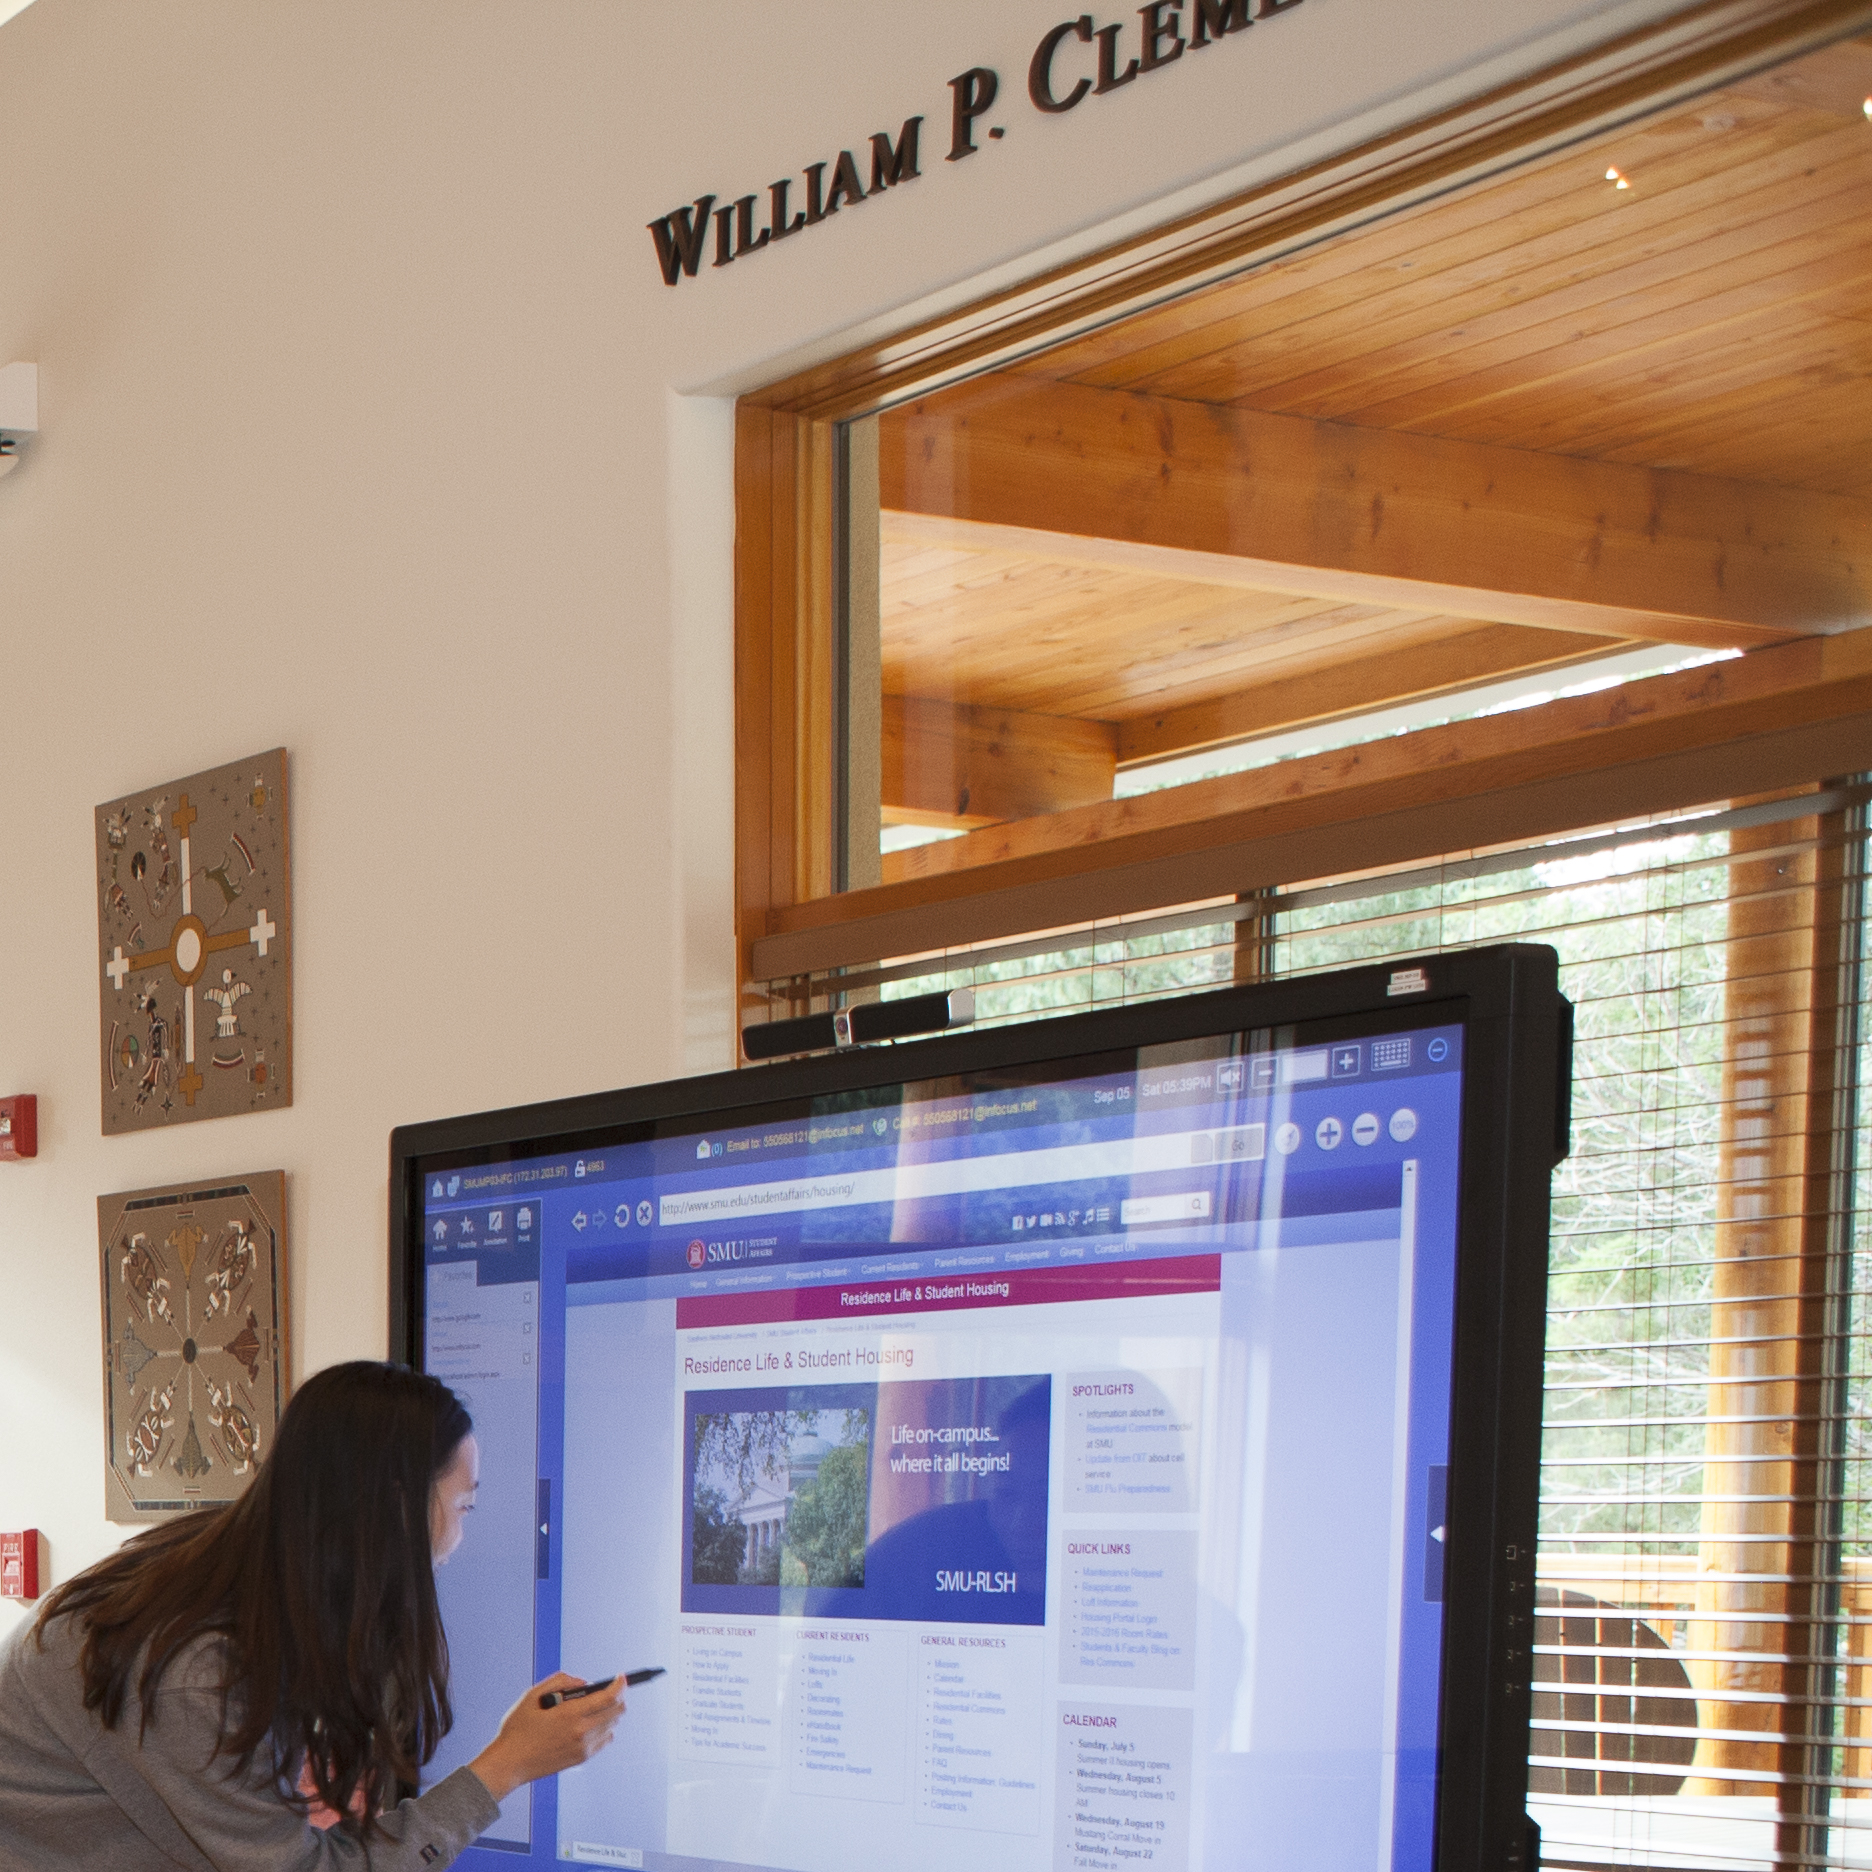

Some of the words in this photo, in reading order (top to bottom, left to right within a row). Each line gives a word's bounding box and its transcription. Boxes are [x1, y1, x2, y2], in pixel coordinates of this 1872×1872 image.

[646, 194, 925, 287] WILLIAM
[944, 66, 1007, 162] P.
[1142, 1083, 1161, 1097] Sat
[1163, 1076, 1212, 1093] 05:39PM
[1094, 1088, 1114, 1105] Sep
[1116, 1087, 1130, 1100] 05
[727, 1139, 750, 1153] Email
[707, 1241, 745, 1264] SMU
[840, 1290, 892, 1307] Residence
[894, 1286, 912, 1302] Life
[914, 1285, 922, 1300] &
[924, 1282, 964, 1300] Student
[966, 1280, 1009, 1298] Housing
[685, 1356, 751, 1375] Residence
[756, 1353, 779, 1371] Life
[784, 1353, 793, 1369] &
[798, 1349, 851, 1368] Student
[856, 1346, 914, 1367] Housing
[1072, 1383, 1134, 1397] SPOTLIGHTS
[1086, 1409, 1127, 1419] Information
[1129, 1409, 1151, 1418] about
[1152, 1408, 1165, 1417] the
[891, 1425, 914, 1444] Life
[1094, 1439, 1113, 1449] SMU
[891, 1453, 932, 1473] where
[934, 1454, 943, 1472] it
[944, 1453, 959, 1472] all
[961, 1453, 1010, 1476] begins!
[1148, 1453, 1170, 1462] about
[1068, 1543, 1099, 1554] QUICK
[1101, 1543, 1131, 1554] LINKS
[936, 1570, 1016, 1593] SMU-RLSH
[681, 1625, 725, 1636] PROSPECTIVE
[727, 1627, 756, 1637] STUDENT
[797, 1630, 828, 1640] CURRENT
[830, 1632, 869, 1642] RESIDENTS
[921, 1635, 956, 1646] GENERAL
[958, 1637, 1006, 1648] RESOURCES
[1063, 1714, 1117, 1728] CALENDAR
[1111, 1741, 1128, 1754] July
[1125, 1772, 1155, 1785] August
[1124, 1817, 1154, 1830] August
[1113, 1846, 1142, 1859] August
